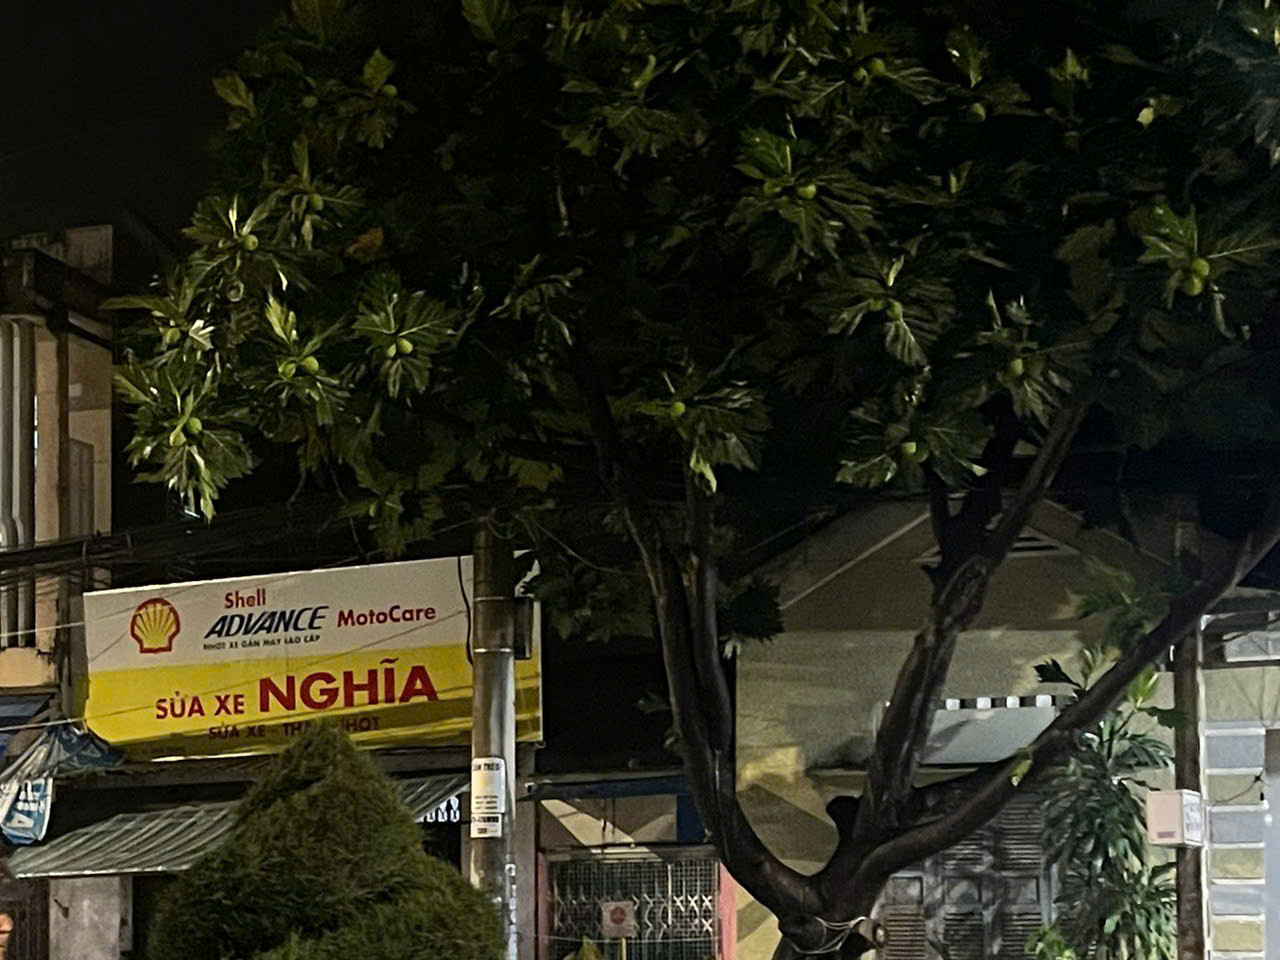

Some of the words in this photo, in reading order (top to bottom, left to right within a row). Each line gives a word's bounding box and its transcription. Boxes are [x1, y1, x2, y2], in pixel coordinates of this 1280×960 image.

[224, 588, 266, 609] Shell
[204, 606, 329, 639] ADVANCE
[337, 605, 436, 628] MotoCare
[214, 693, 245, 716] XE
[258, 657, 440, 713] NGHĨA
[246, 725, 266, 738] XE
